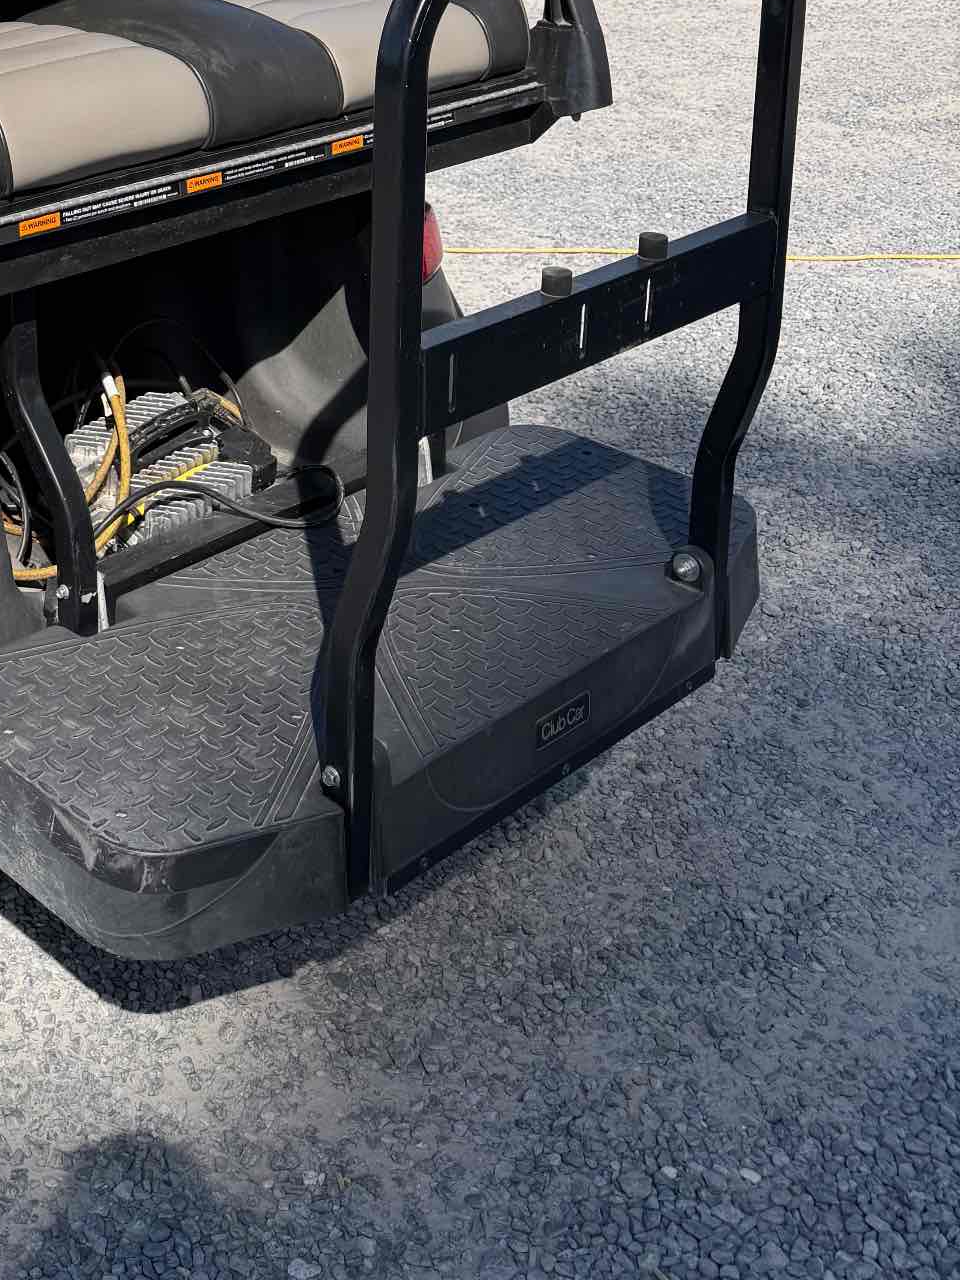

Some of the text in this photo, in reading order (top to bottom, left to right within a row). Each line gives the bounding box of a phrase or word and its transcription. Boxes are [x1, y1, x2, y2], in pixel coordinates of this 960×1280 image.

[27, 216, 57, 230] WARNING
[541, 705, 585, 740] Club Car
